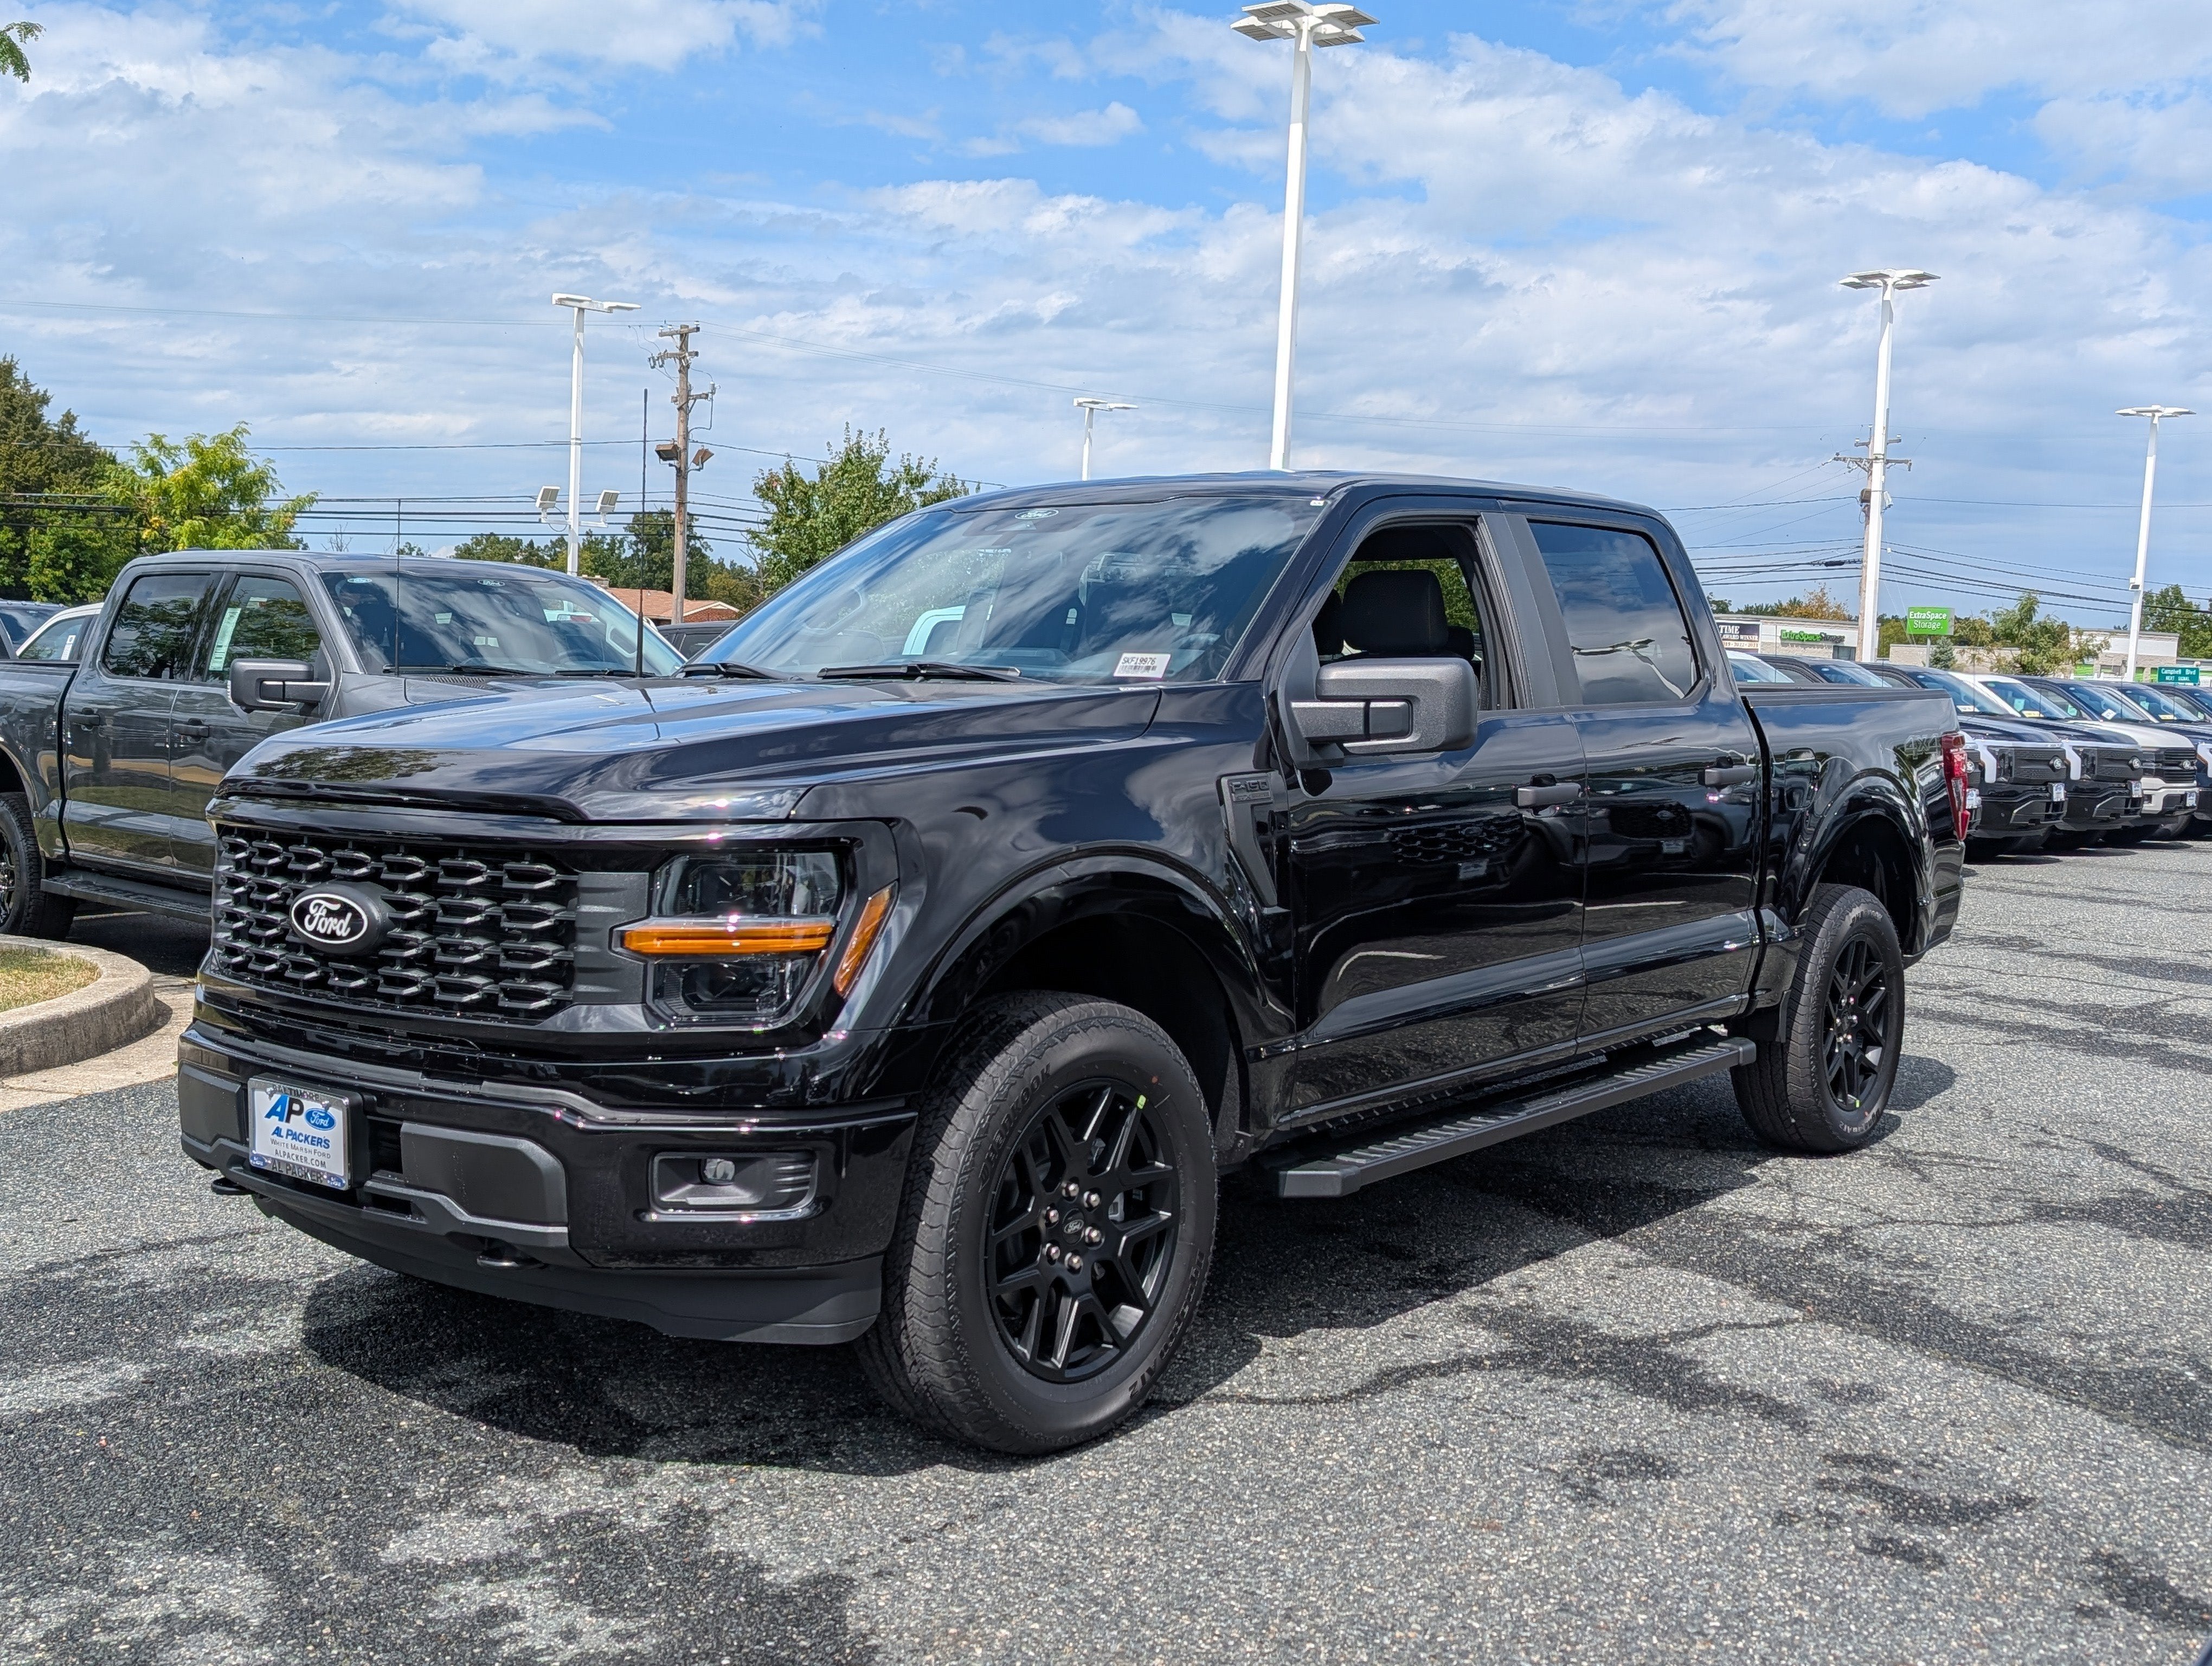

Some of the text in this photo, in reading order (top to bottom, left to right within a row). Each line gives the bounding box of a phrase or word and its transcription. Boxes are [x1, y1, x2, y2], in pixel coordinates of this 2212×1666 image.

[1719, 625, 1740, 634] TIME
[304, 899, 352, 937] Ford
[264, 1094, 304, 1124] AP
[310, 1111, 330, 1126] Ford
[271, 1126, 331, 1149] AL PACKER'S
[275, 1149, 326, 1168] ALPACKER.COM
[291, 1143, 313, 1154] MARSH
[313, 1149, 331, 1159] FORD
[272, 1160, 283, 1172] AL
[285, 1163, 323, 1183] PACKER
